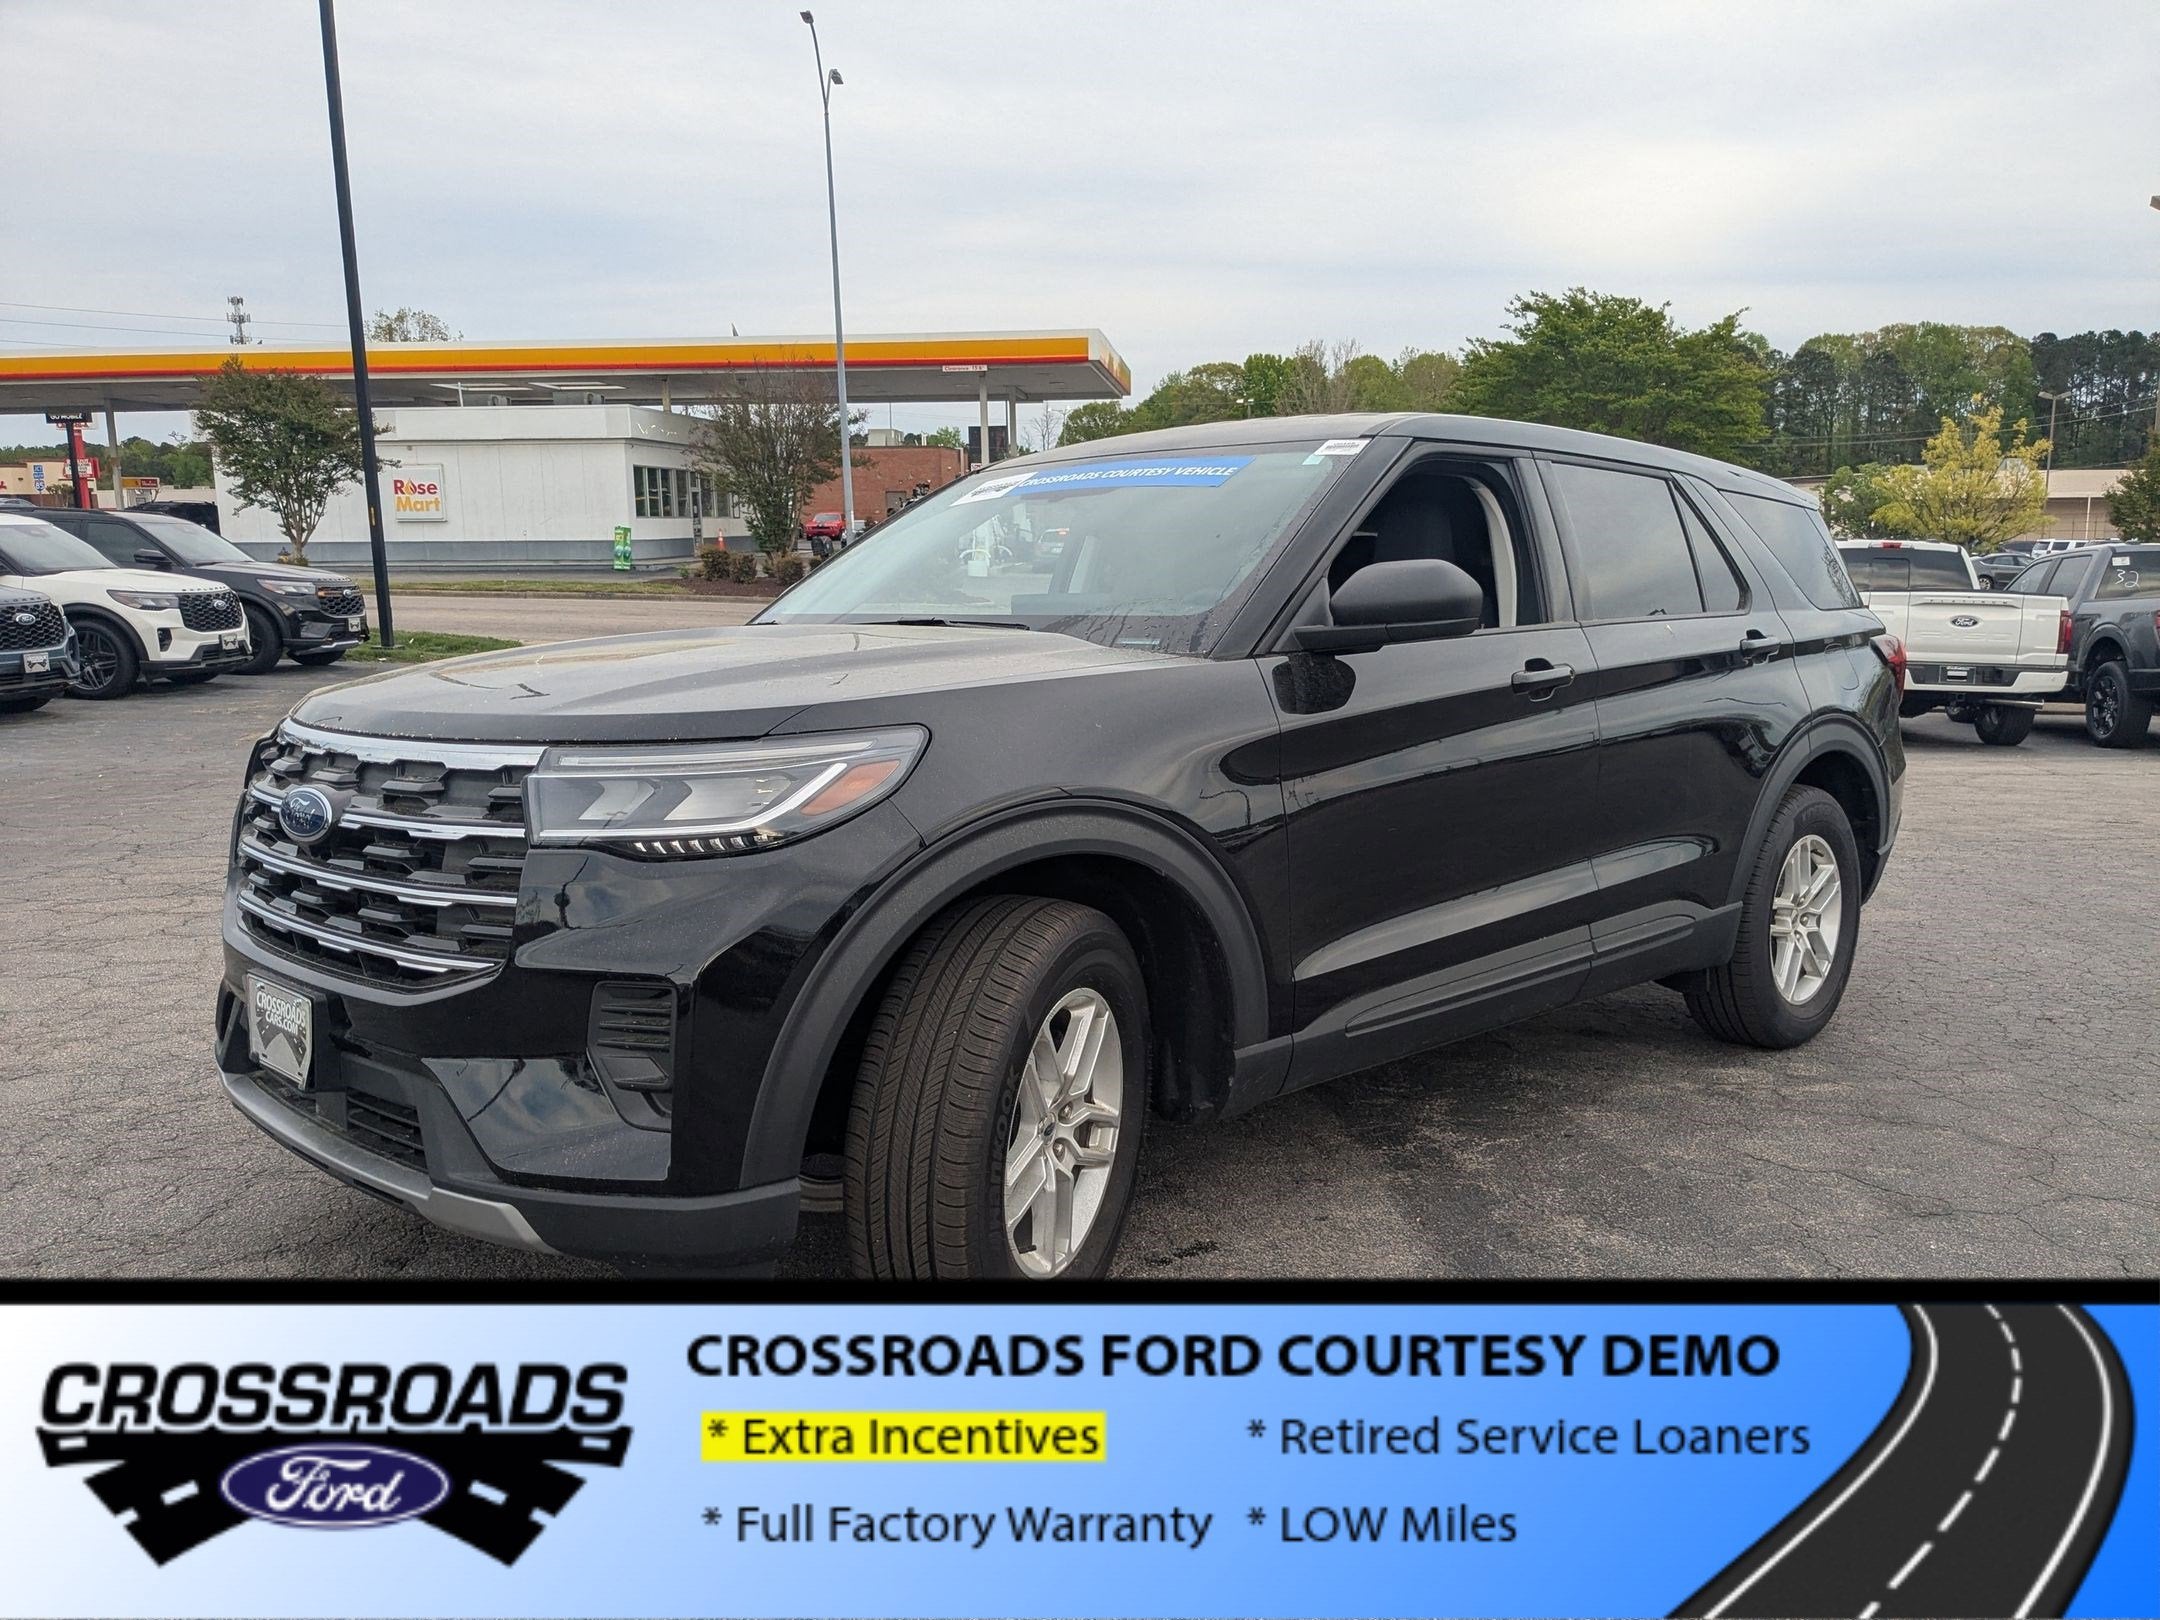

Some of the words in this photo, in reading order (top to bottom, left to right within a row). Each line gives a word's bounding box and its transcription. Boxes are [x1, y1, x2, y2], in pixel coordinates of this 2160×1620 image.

[1019, 471, 1102, 487] CROSSROADS
[1101, 467, 1176, 479] COURTESY
[1174, 466, 1239, 476] VEHICLE
[396, 496, 440, 512] Mart
[2115, 569, 2140, 588] 32
[1954, 617, 1975, 626] Ford
[289, 797, 317, 829] Ford
[256, 991, 306, 1028] CROSSROADS
[265, 1010, 299, 1036] CARS.COM
